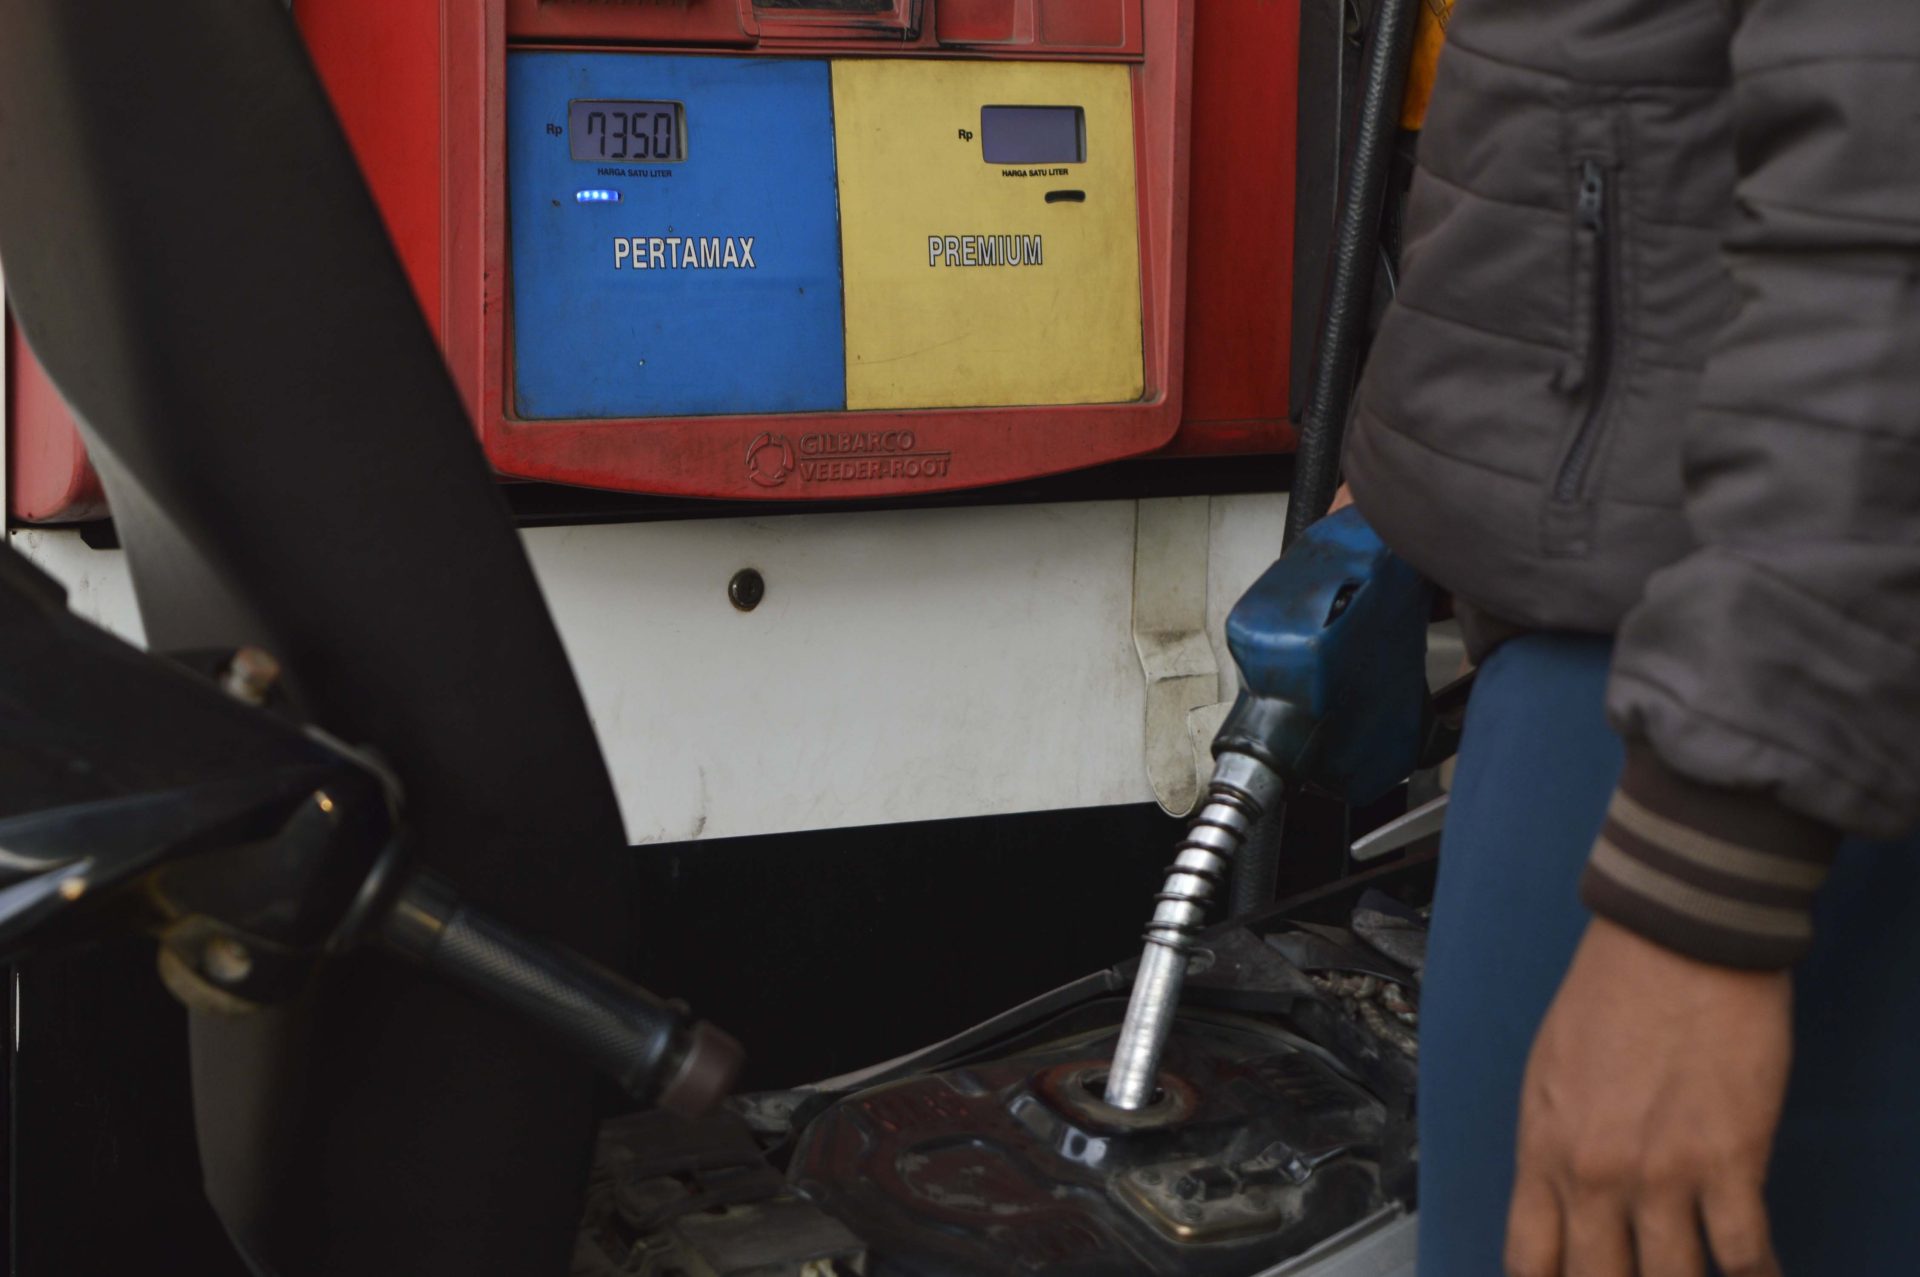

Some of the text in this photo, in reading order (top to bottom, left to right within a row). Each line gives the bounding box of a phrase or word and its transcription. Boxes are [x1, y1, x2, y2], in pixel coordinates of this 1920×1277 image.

[546, 123, 563, 137] Rp
[587, 112, 672, 159] 7350
[958, 129, 973, 142] Rp
[597, 168, 673, 177] HARGA SATU LITER
[1002, 168, 1069, 177] HARGA SATU LITER
[613, 236, 757, 269] PERTAMAX
[928, 235, 1043, 267] PREMIUM
[800, 431, 916, 455] GILBARCO
[800, 457, 950, 482] VEEDER-ROOT
